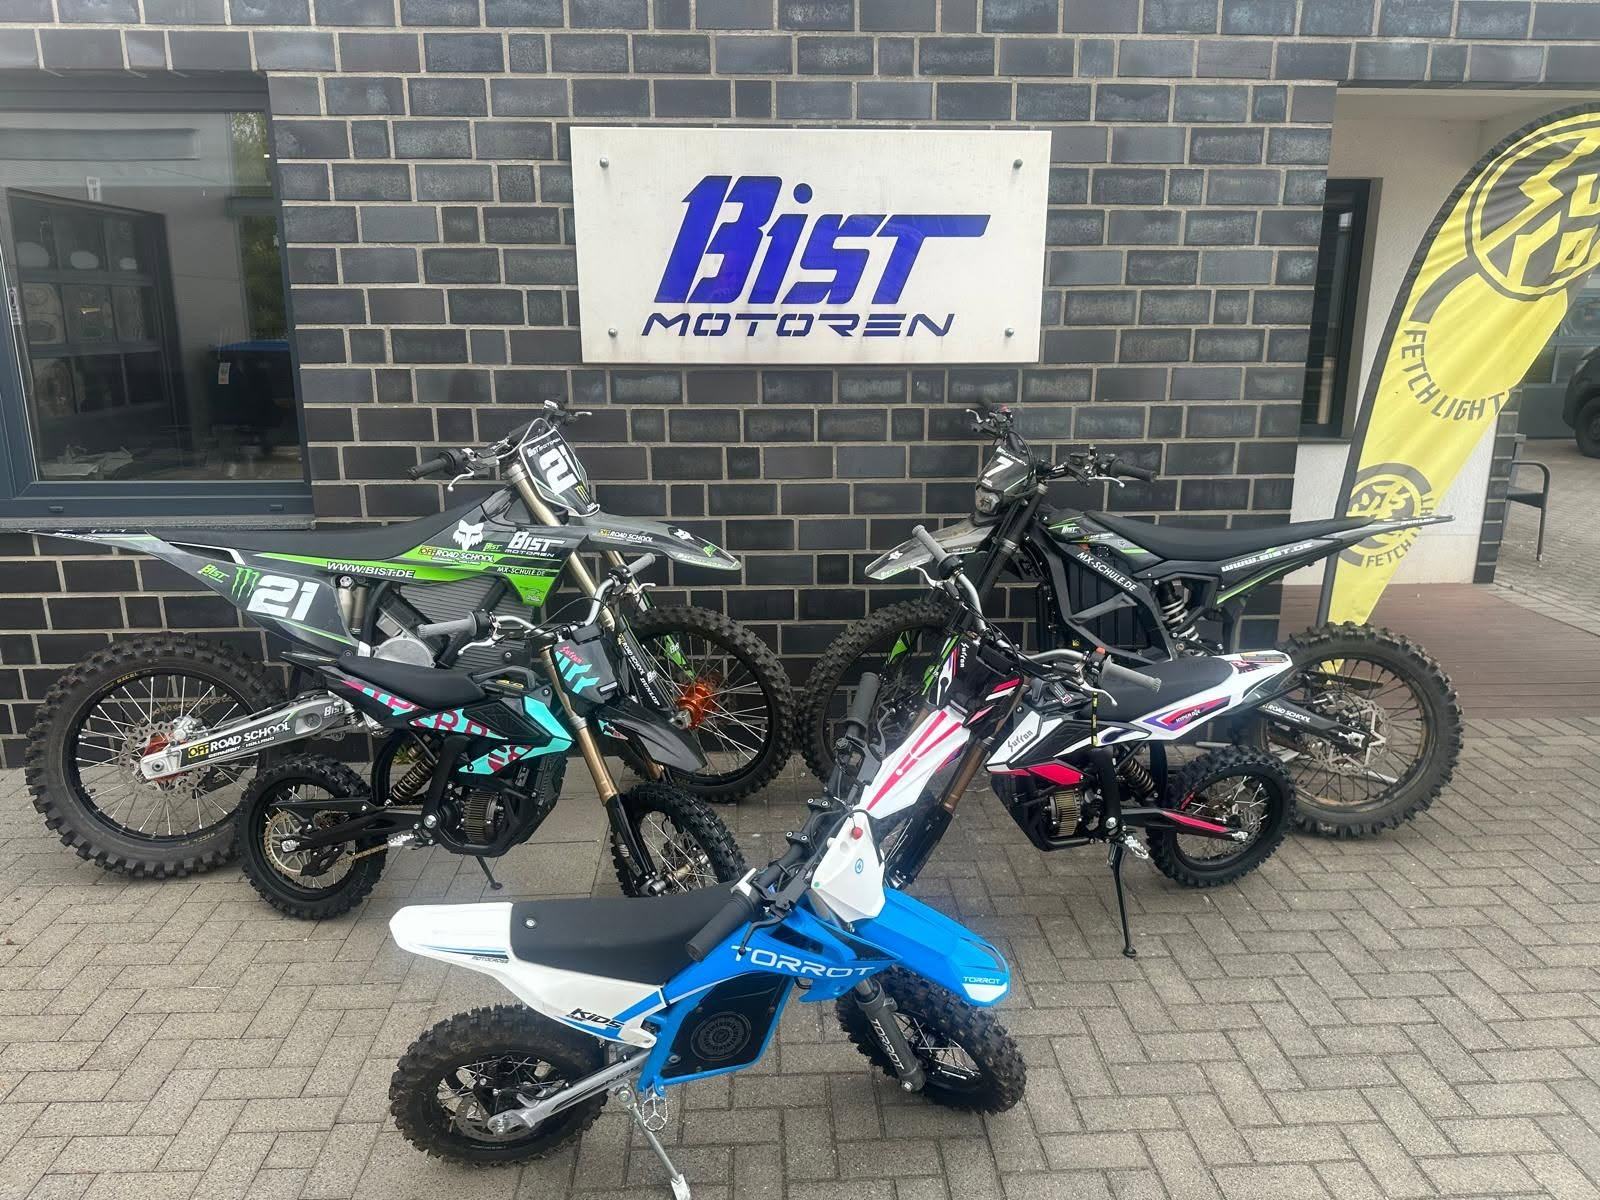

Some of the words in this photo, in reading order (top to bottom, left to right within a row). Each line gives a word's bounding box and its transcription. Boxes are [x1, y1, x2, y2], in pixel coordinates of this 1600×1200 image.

[641, 313, 955, 337] MOTOREN
[1402, 330, 1441, 405] FETCH
[1431, 392, 1505, 421] LIGHT
[539, 444, 582, 495] 21
[985, 455, 1014, 477] 7
[508, 531, 565, 552] BIST
[628, 533, 653, 543] SCHOOL
[459, 552, 494, 562] SCHOOL
[505, 549, 555, 558] MOTOREN
[1077, 552, 1137, 592] MX-SCHULE.DE
[247, 574, 320, 621] 21
[640, 677, 661, 706] DUNLOP
[1285, 710, 1310, 722] SCHOOL
[210, 735, 242, 752] ROAD
[243, 721, 291, 742] SCHOOL
[731, 945, 876, 978] TORROT
[963, 976, 1001, 985] TORROT
[871, 1018, 905, 1070] TORROT
